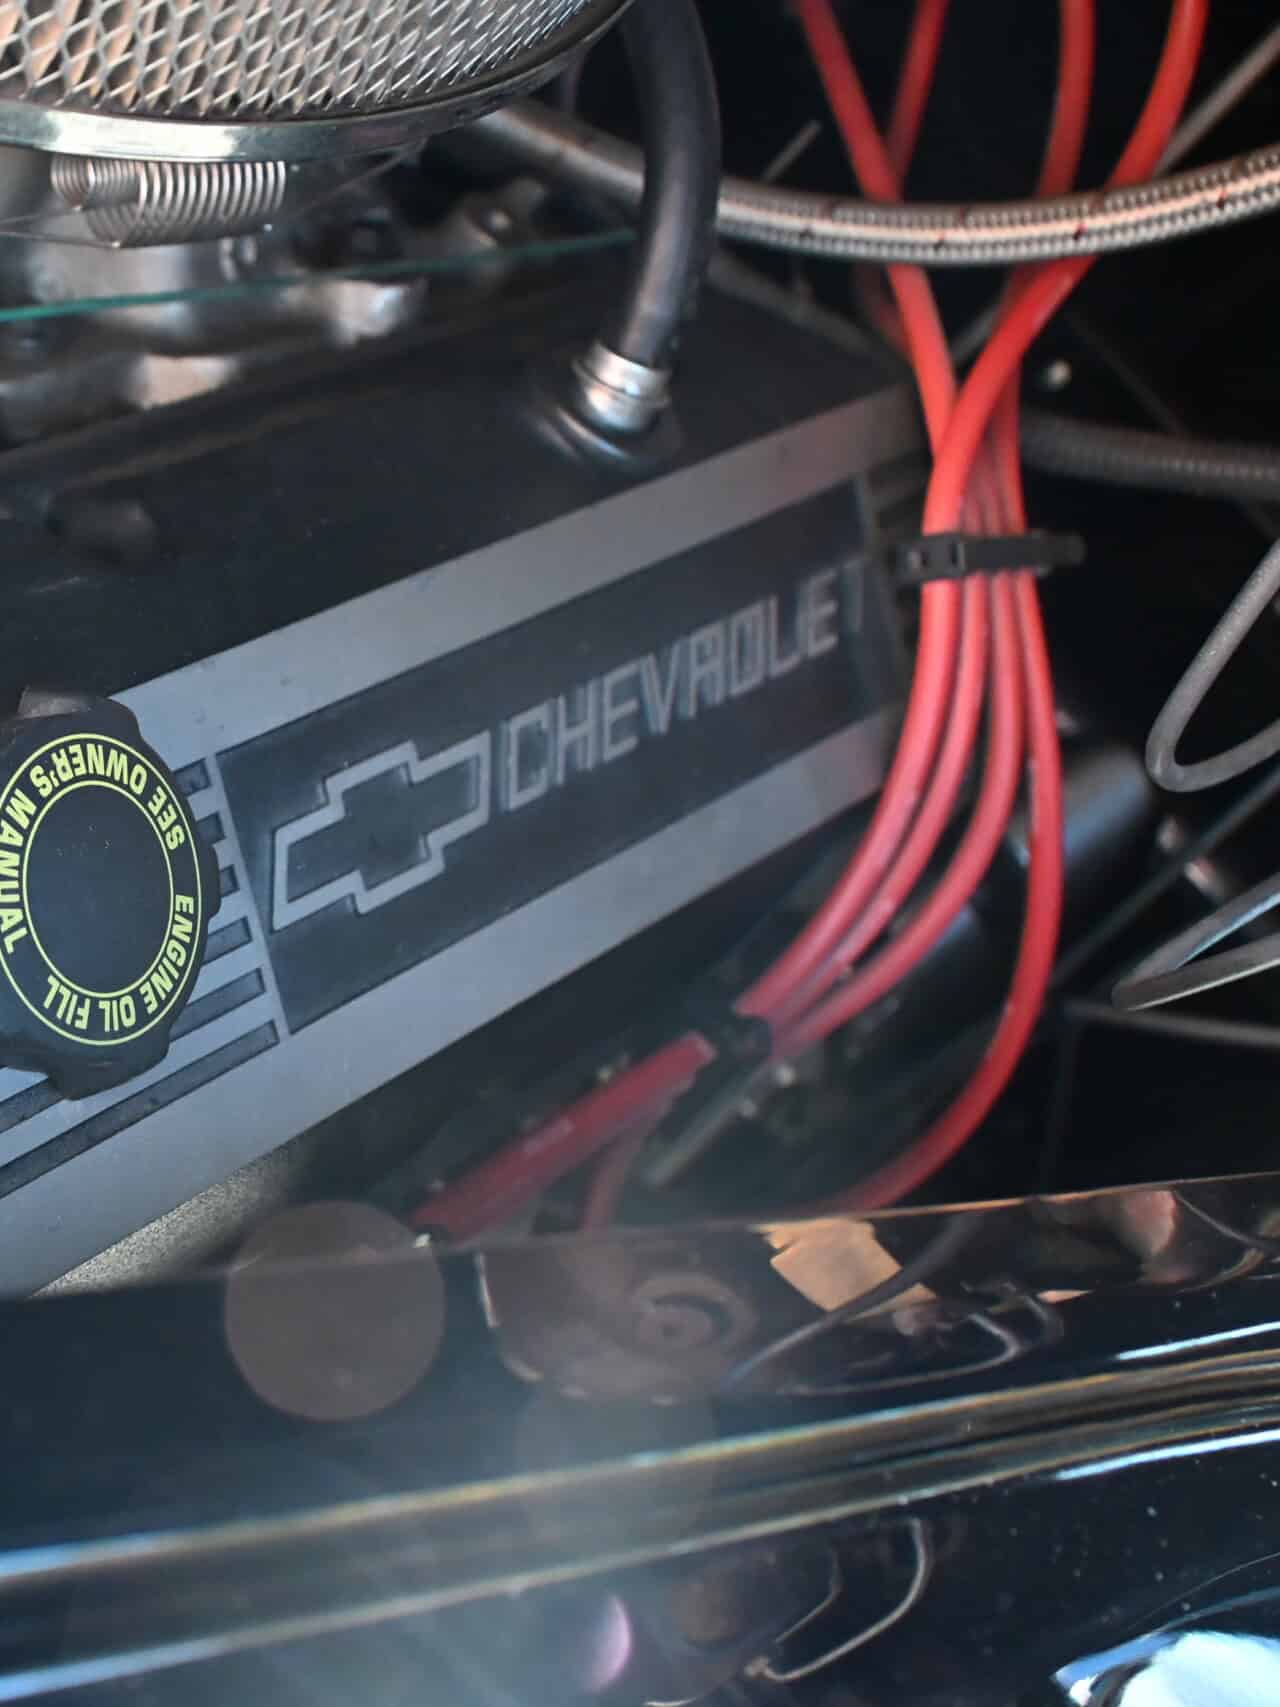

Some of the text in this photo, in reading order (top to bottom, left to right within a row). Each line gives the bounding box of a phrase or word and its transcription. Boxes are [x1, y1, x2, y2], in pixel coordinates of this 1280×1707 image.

[501, 556, 870, 812] CHEVROLET
[29, 743, 148, 798] OWNER'S
[148, 785, 186, 851] SEE
[42, 894, 195, 1032] ENGINE OIL FILL
